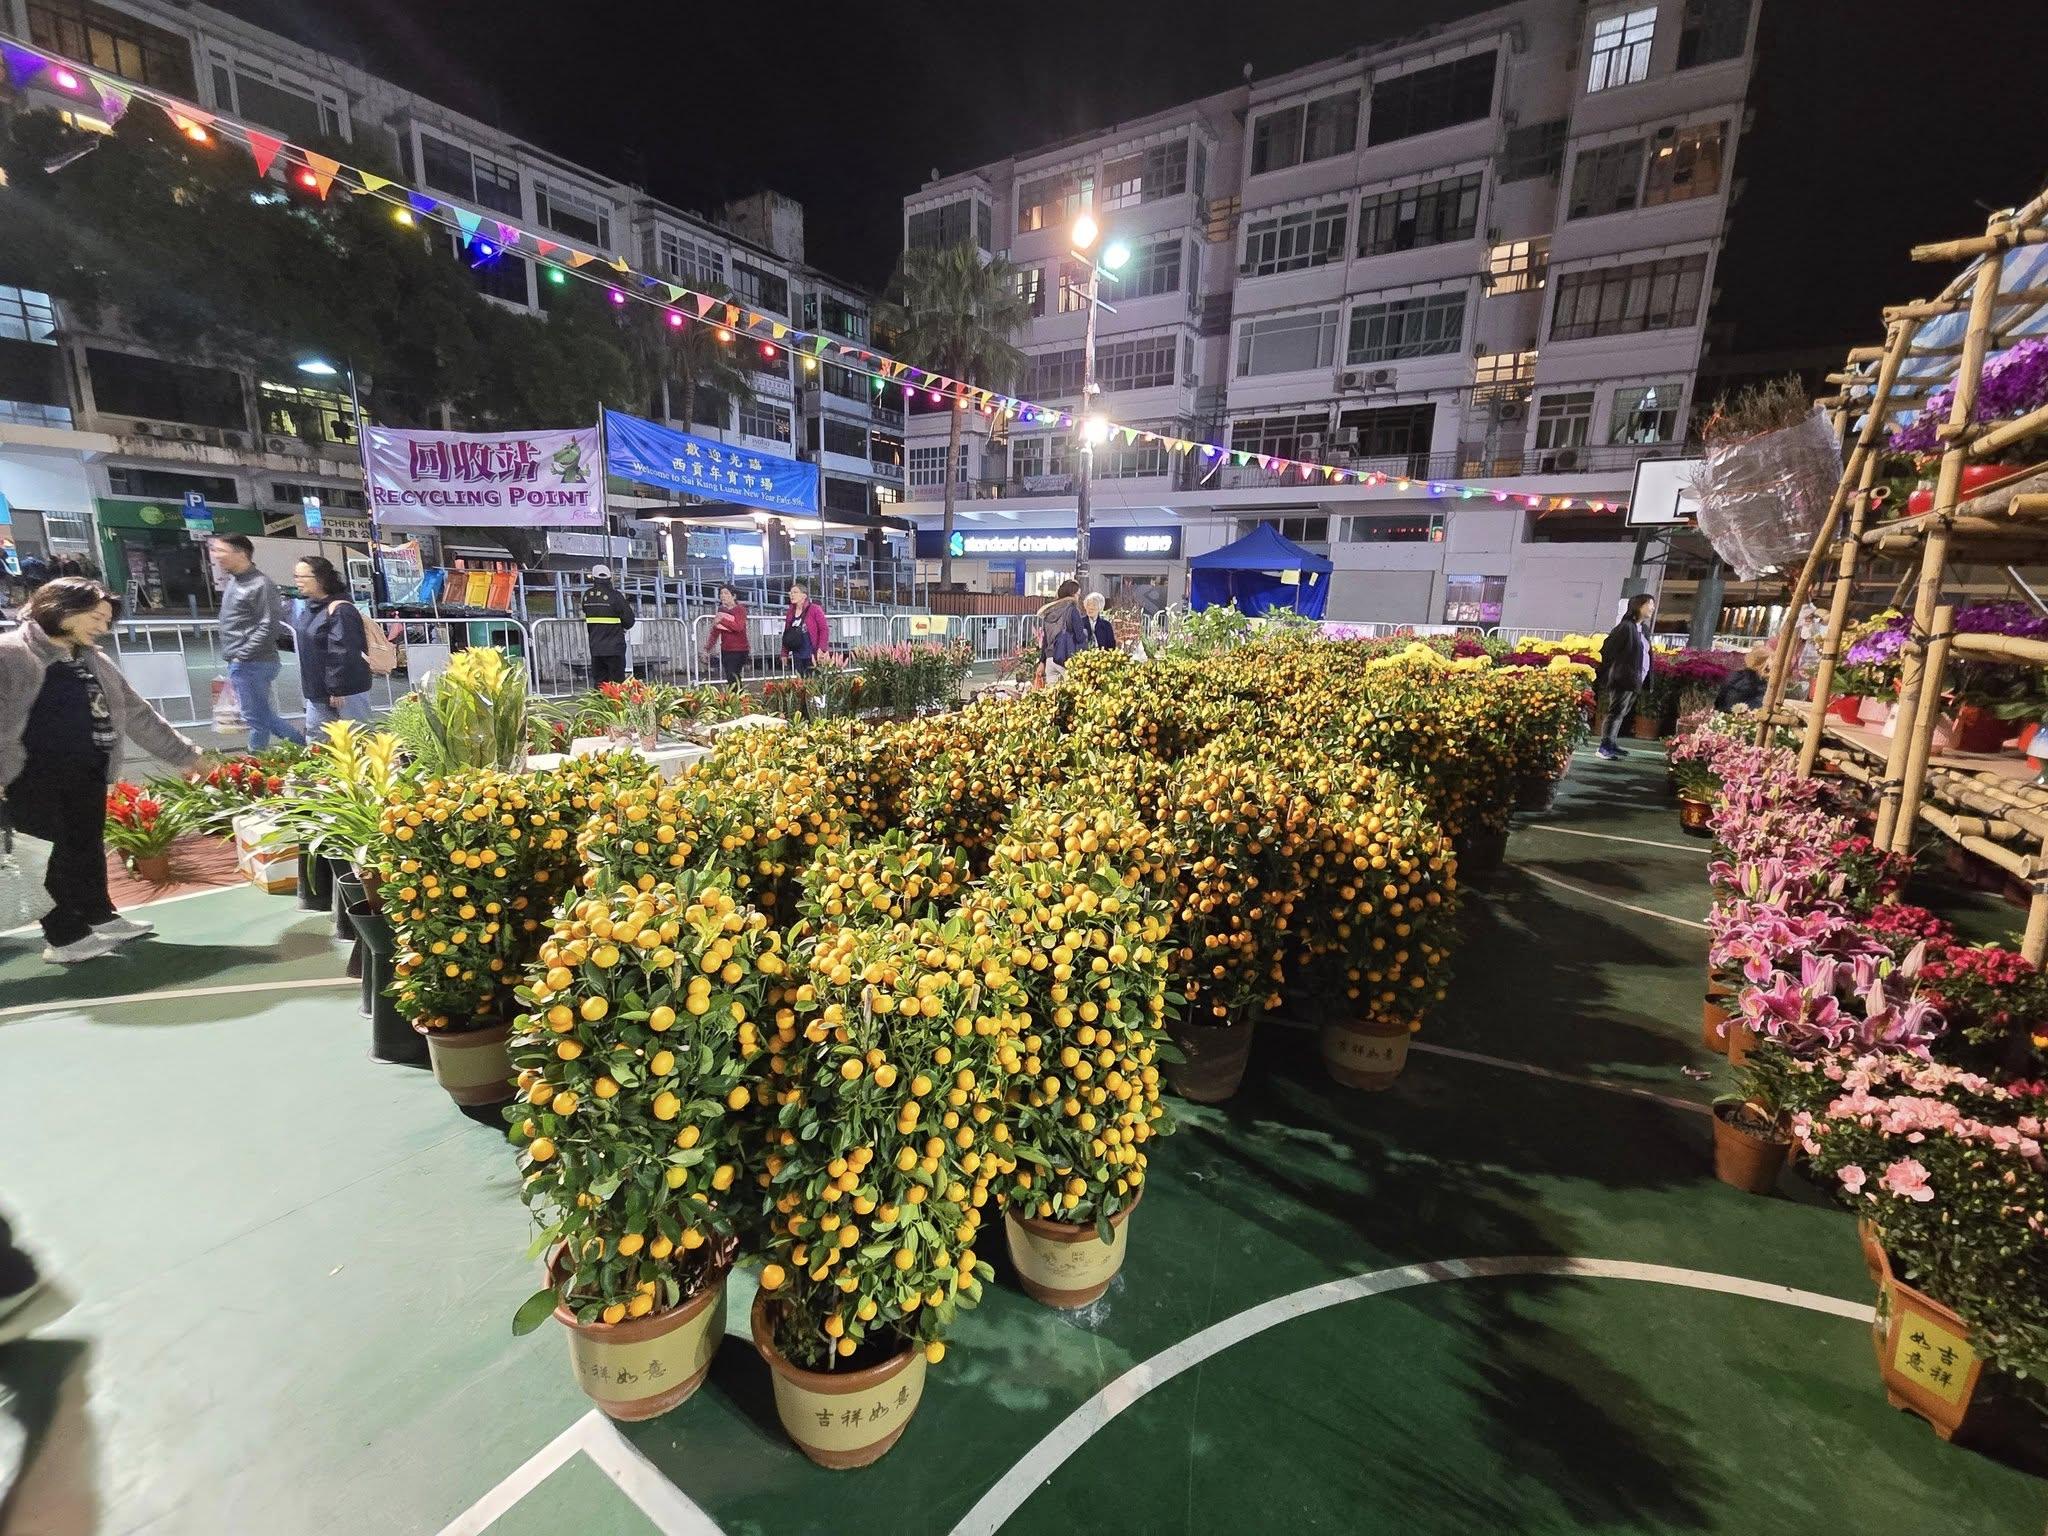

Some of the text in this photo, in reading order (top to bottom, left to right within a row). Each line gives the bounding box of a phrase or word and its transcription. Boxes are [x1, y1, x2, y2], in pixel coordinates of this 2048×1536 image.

[409, 439, 541, 483] 回收站
[672, 458, 773, 492] 西貢年宵市場
[189, 494, 201, 507] P
[373, 487, 591, 506] RECYCLING POINT
[633, 462, 670, 480] Welcome
[671, 474, 680, 482] to
[681, 476, 694, 486] Sai
[696, 479, 718, 492] Kung
[743, 488, 760, 498] New
[761, 492, 775, 502] Year
[322, 519, 355, 529] TCHER
[1903, 1331, 1931, 1373] 如意
[1930, 1346, 1959, 1389] 吉祥
[815, 1385, 910, 1428] 吉祥如意
